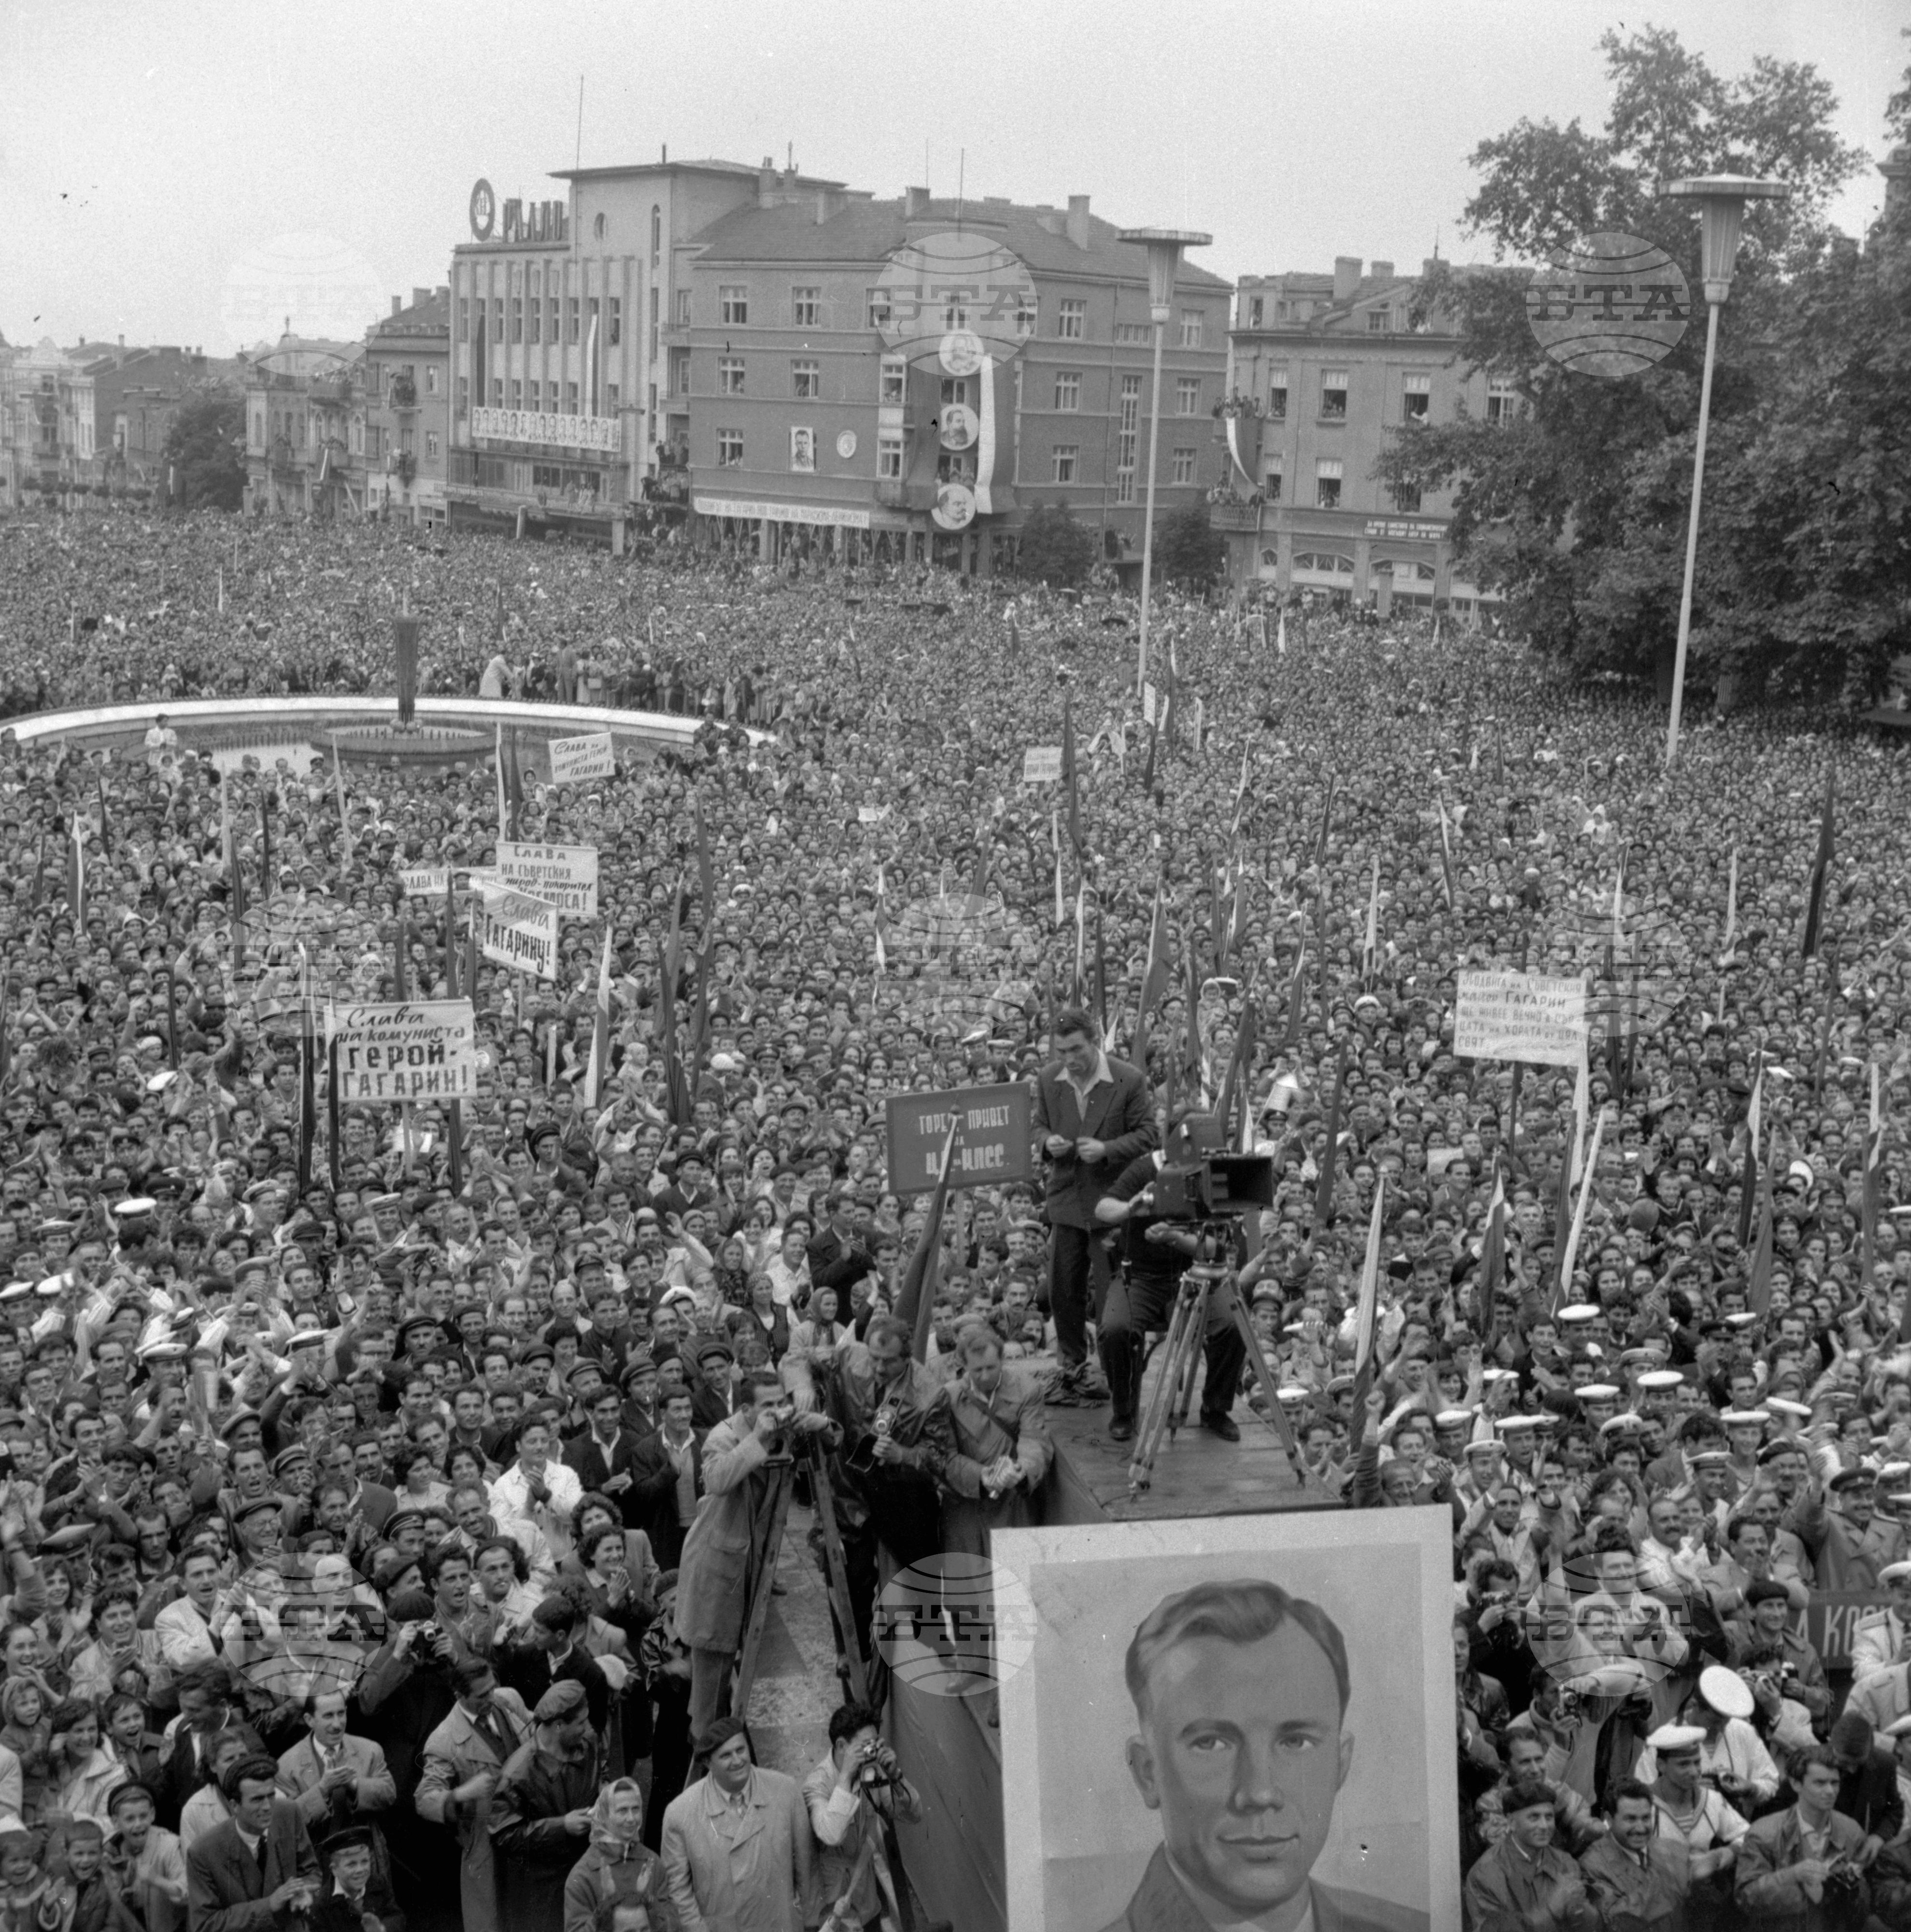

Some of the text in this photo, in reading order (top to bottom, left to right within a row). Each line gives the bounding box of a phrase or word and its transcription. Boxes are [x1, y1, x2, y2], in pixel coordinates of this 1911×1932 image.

[502, 864, 513, 875] НА
[347, 1006, 424, 1028] Слава
[919, 1105, 1009, 1135] ГОРЕ ПРИВЕТ
